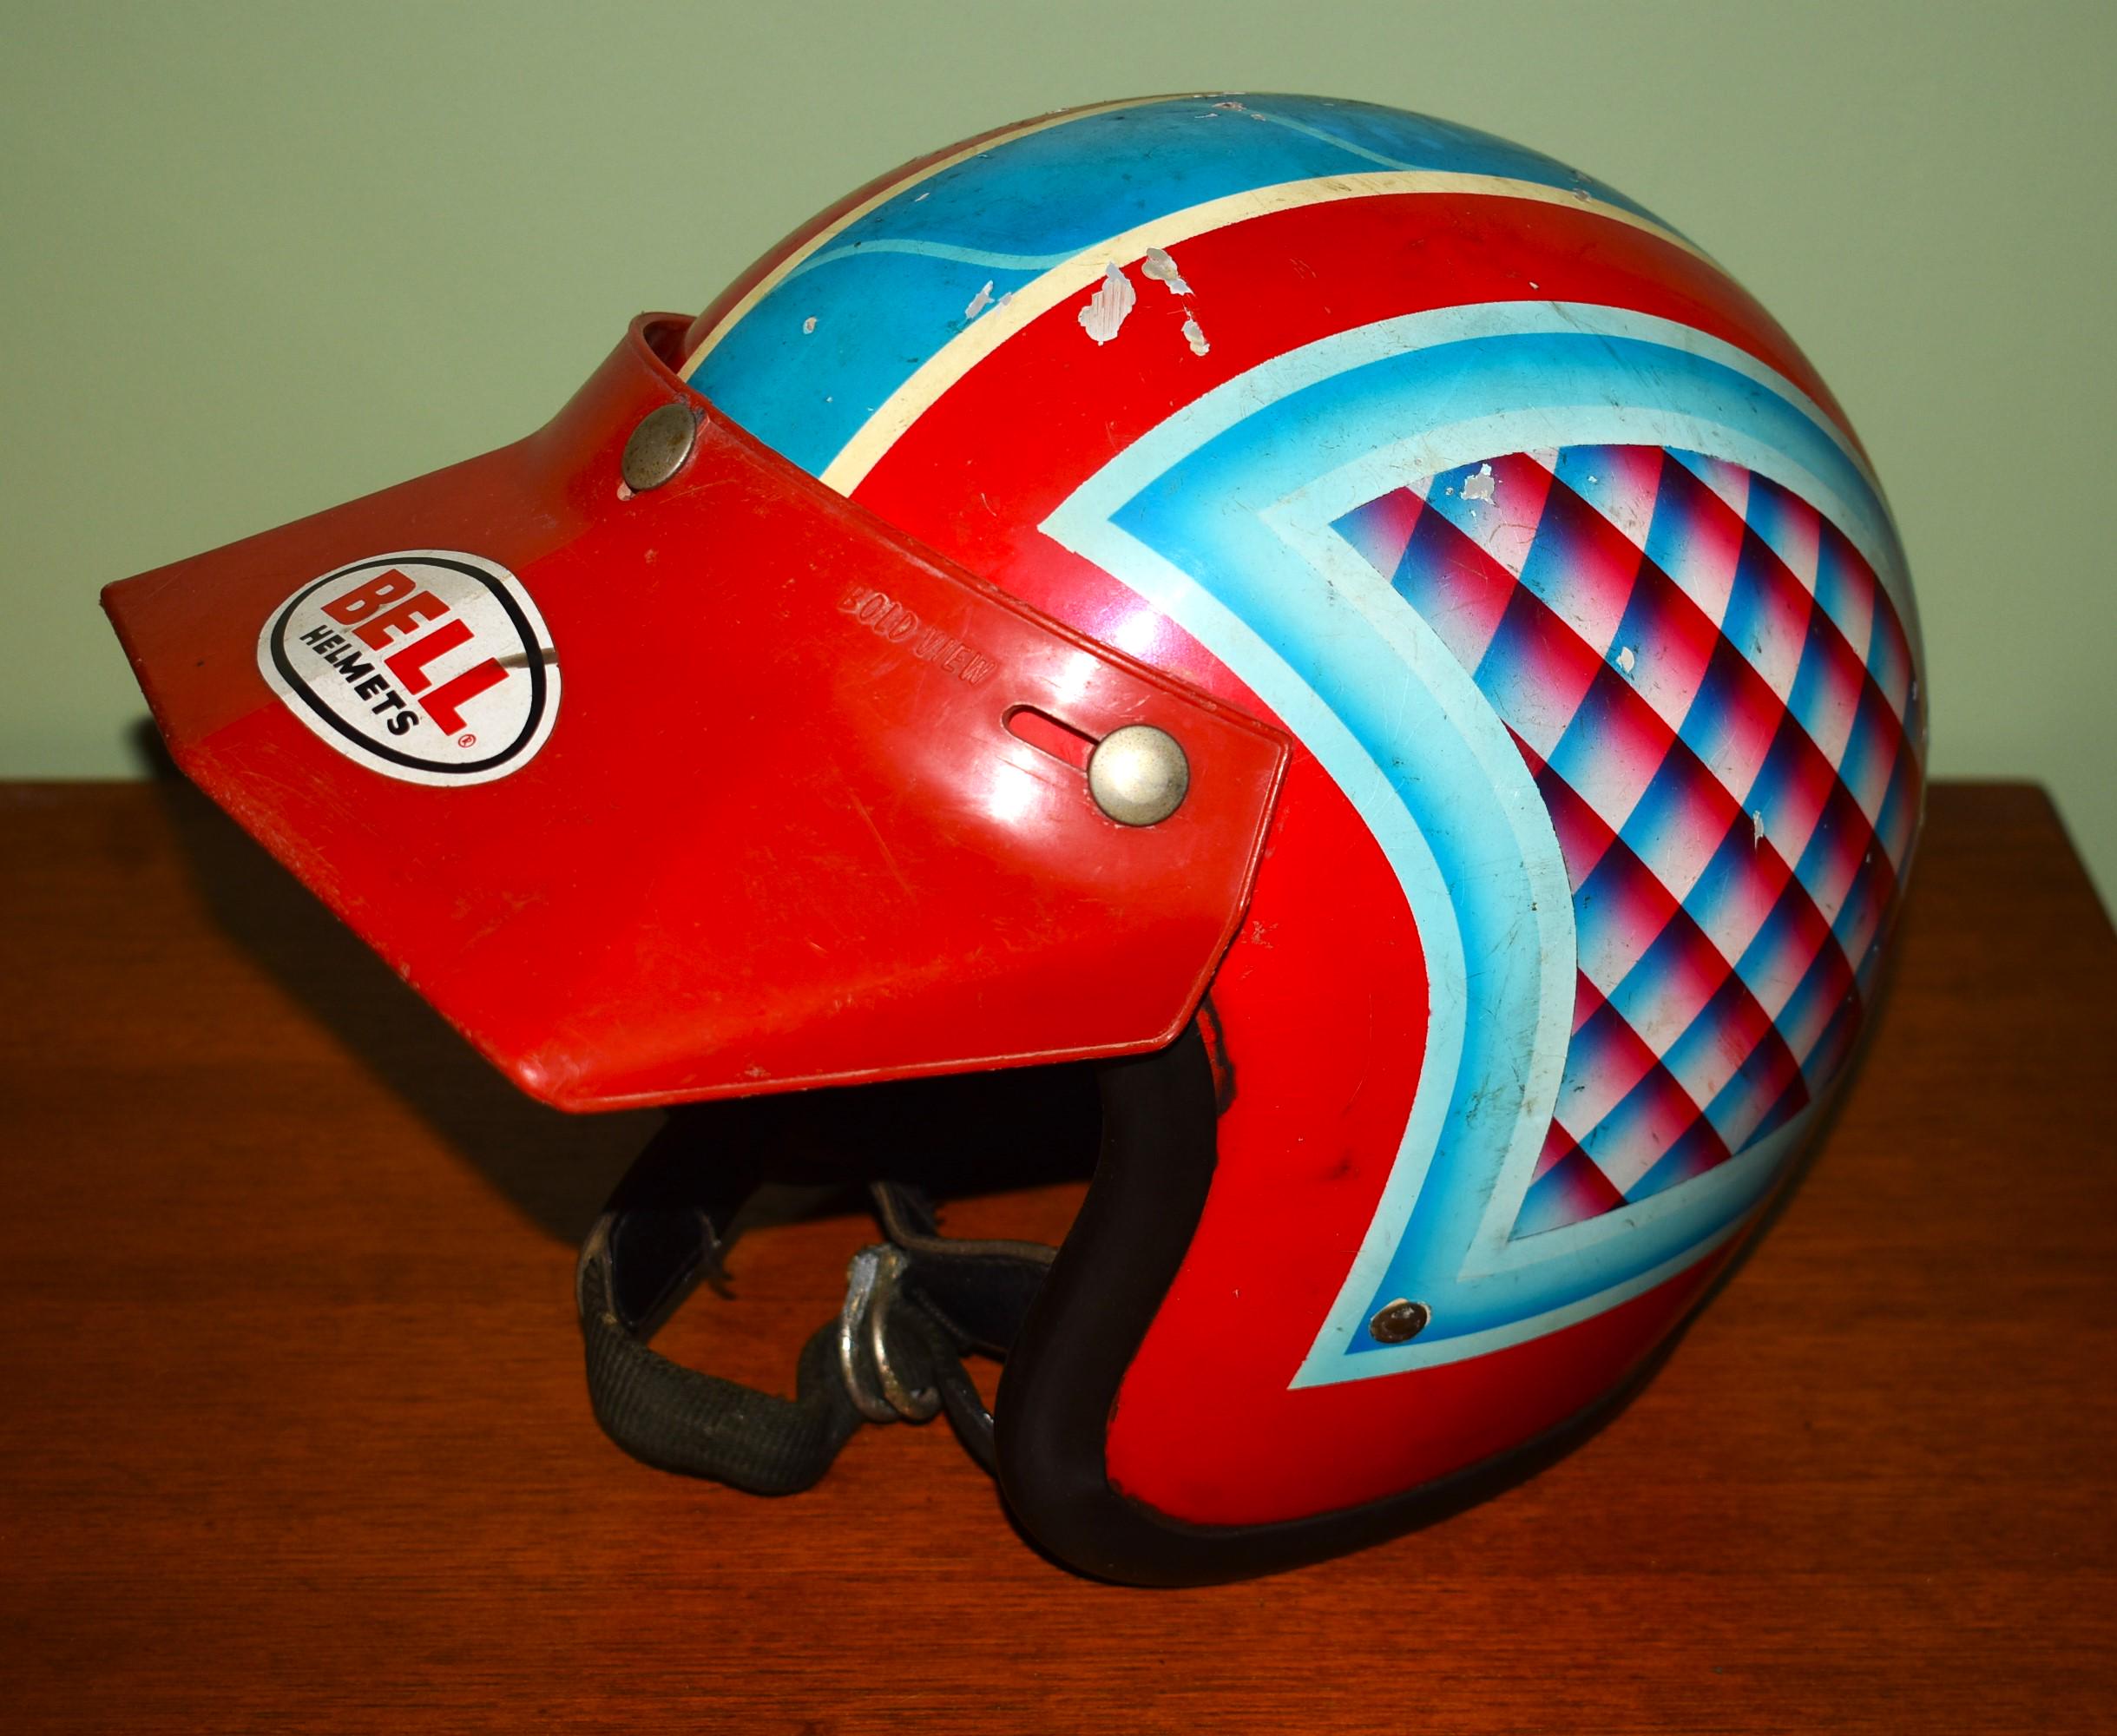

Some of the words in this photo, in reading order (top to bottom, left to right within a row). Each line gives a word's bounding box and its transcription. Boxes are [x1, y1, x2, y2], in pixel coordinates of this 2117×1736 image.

[299, 624, 420, 736] HELMETS
[320, 569, 510, 736] BELL
[914, 625, 997, 686] VIEW
